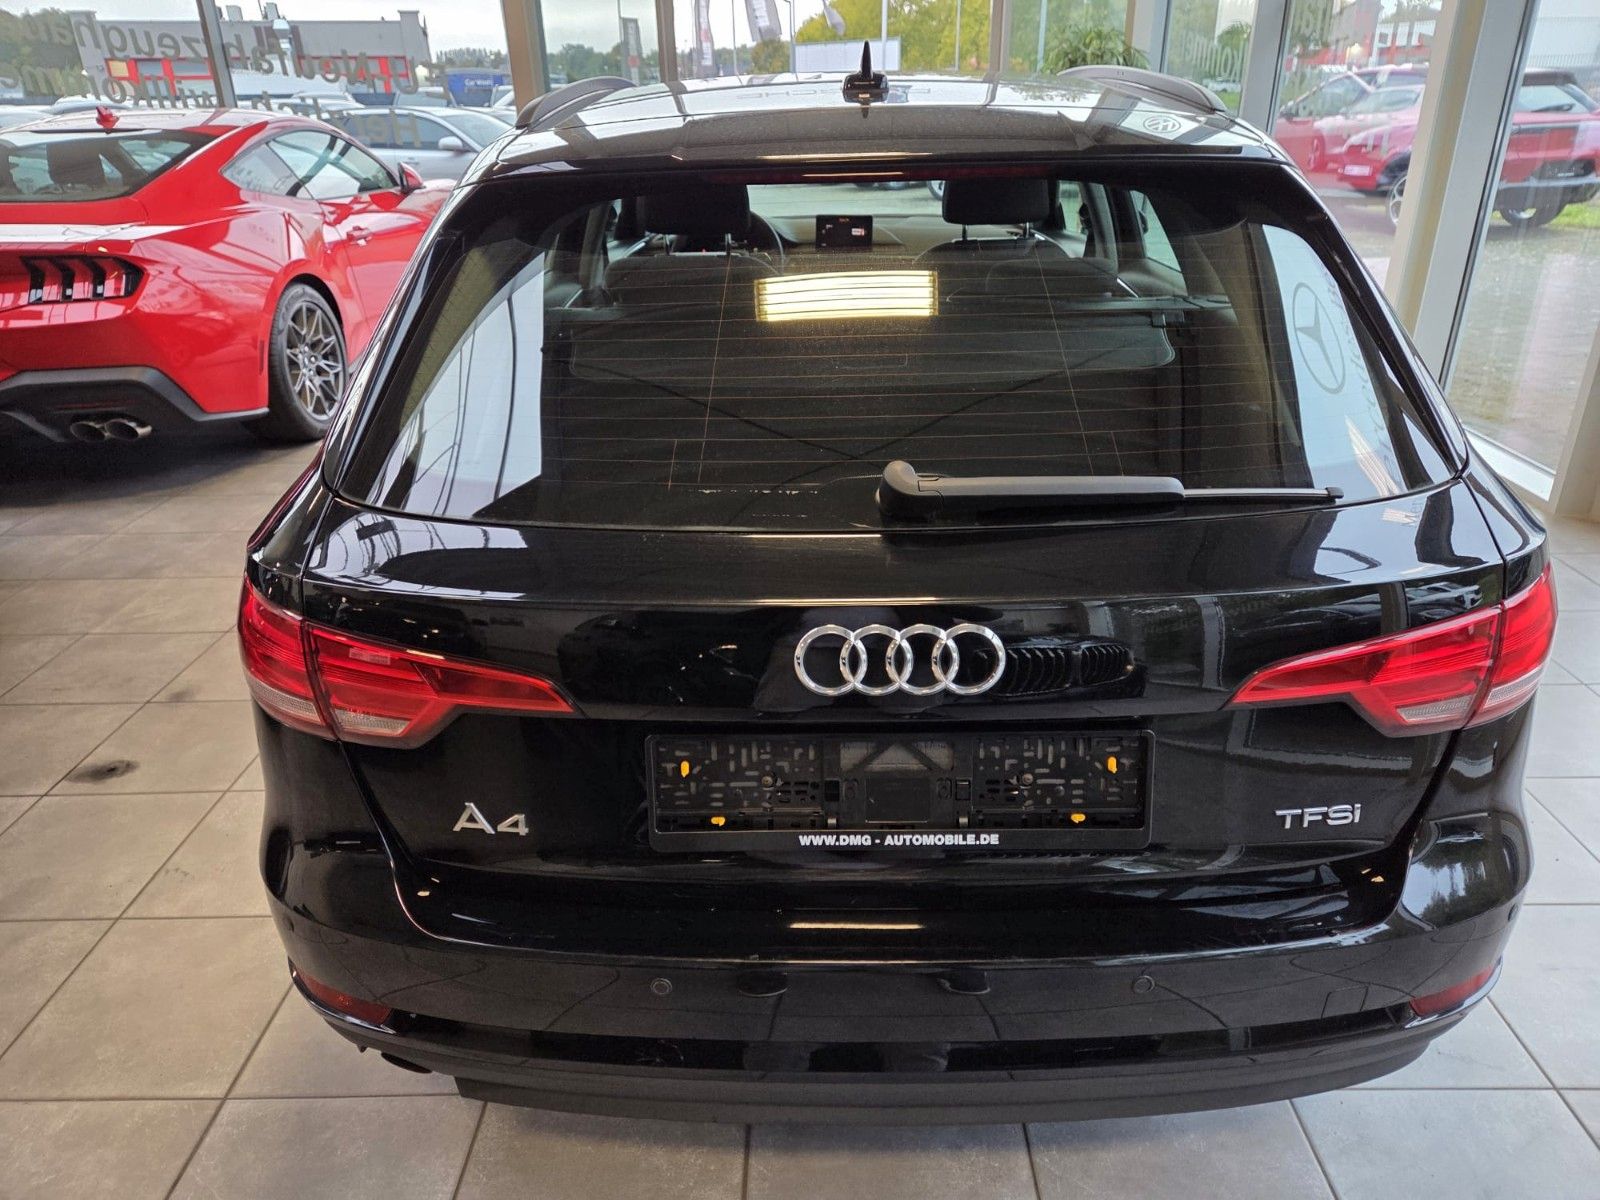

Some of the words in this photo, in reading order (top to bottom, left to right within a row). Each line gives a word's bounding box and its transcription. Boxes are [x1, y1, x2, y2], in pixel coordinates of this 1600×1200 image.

[452, 802, 530, 836] A4
[799, 835, 872, 846] WWW.DMG
[884, 834, 1000, 846] AUTOMOBILE.DE
